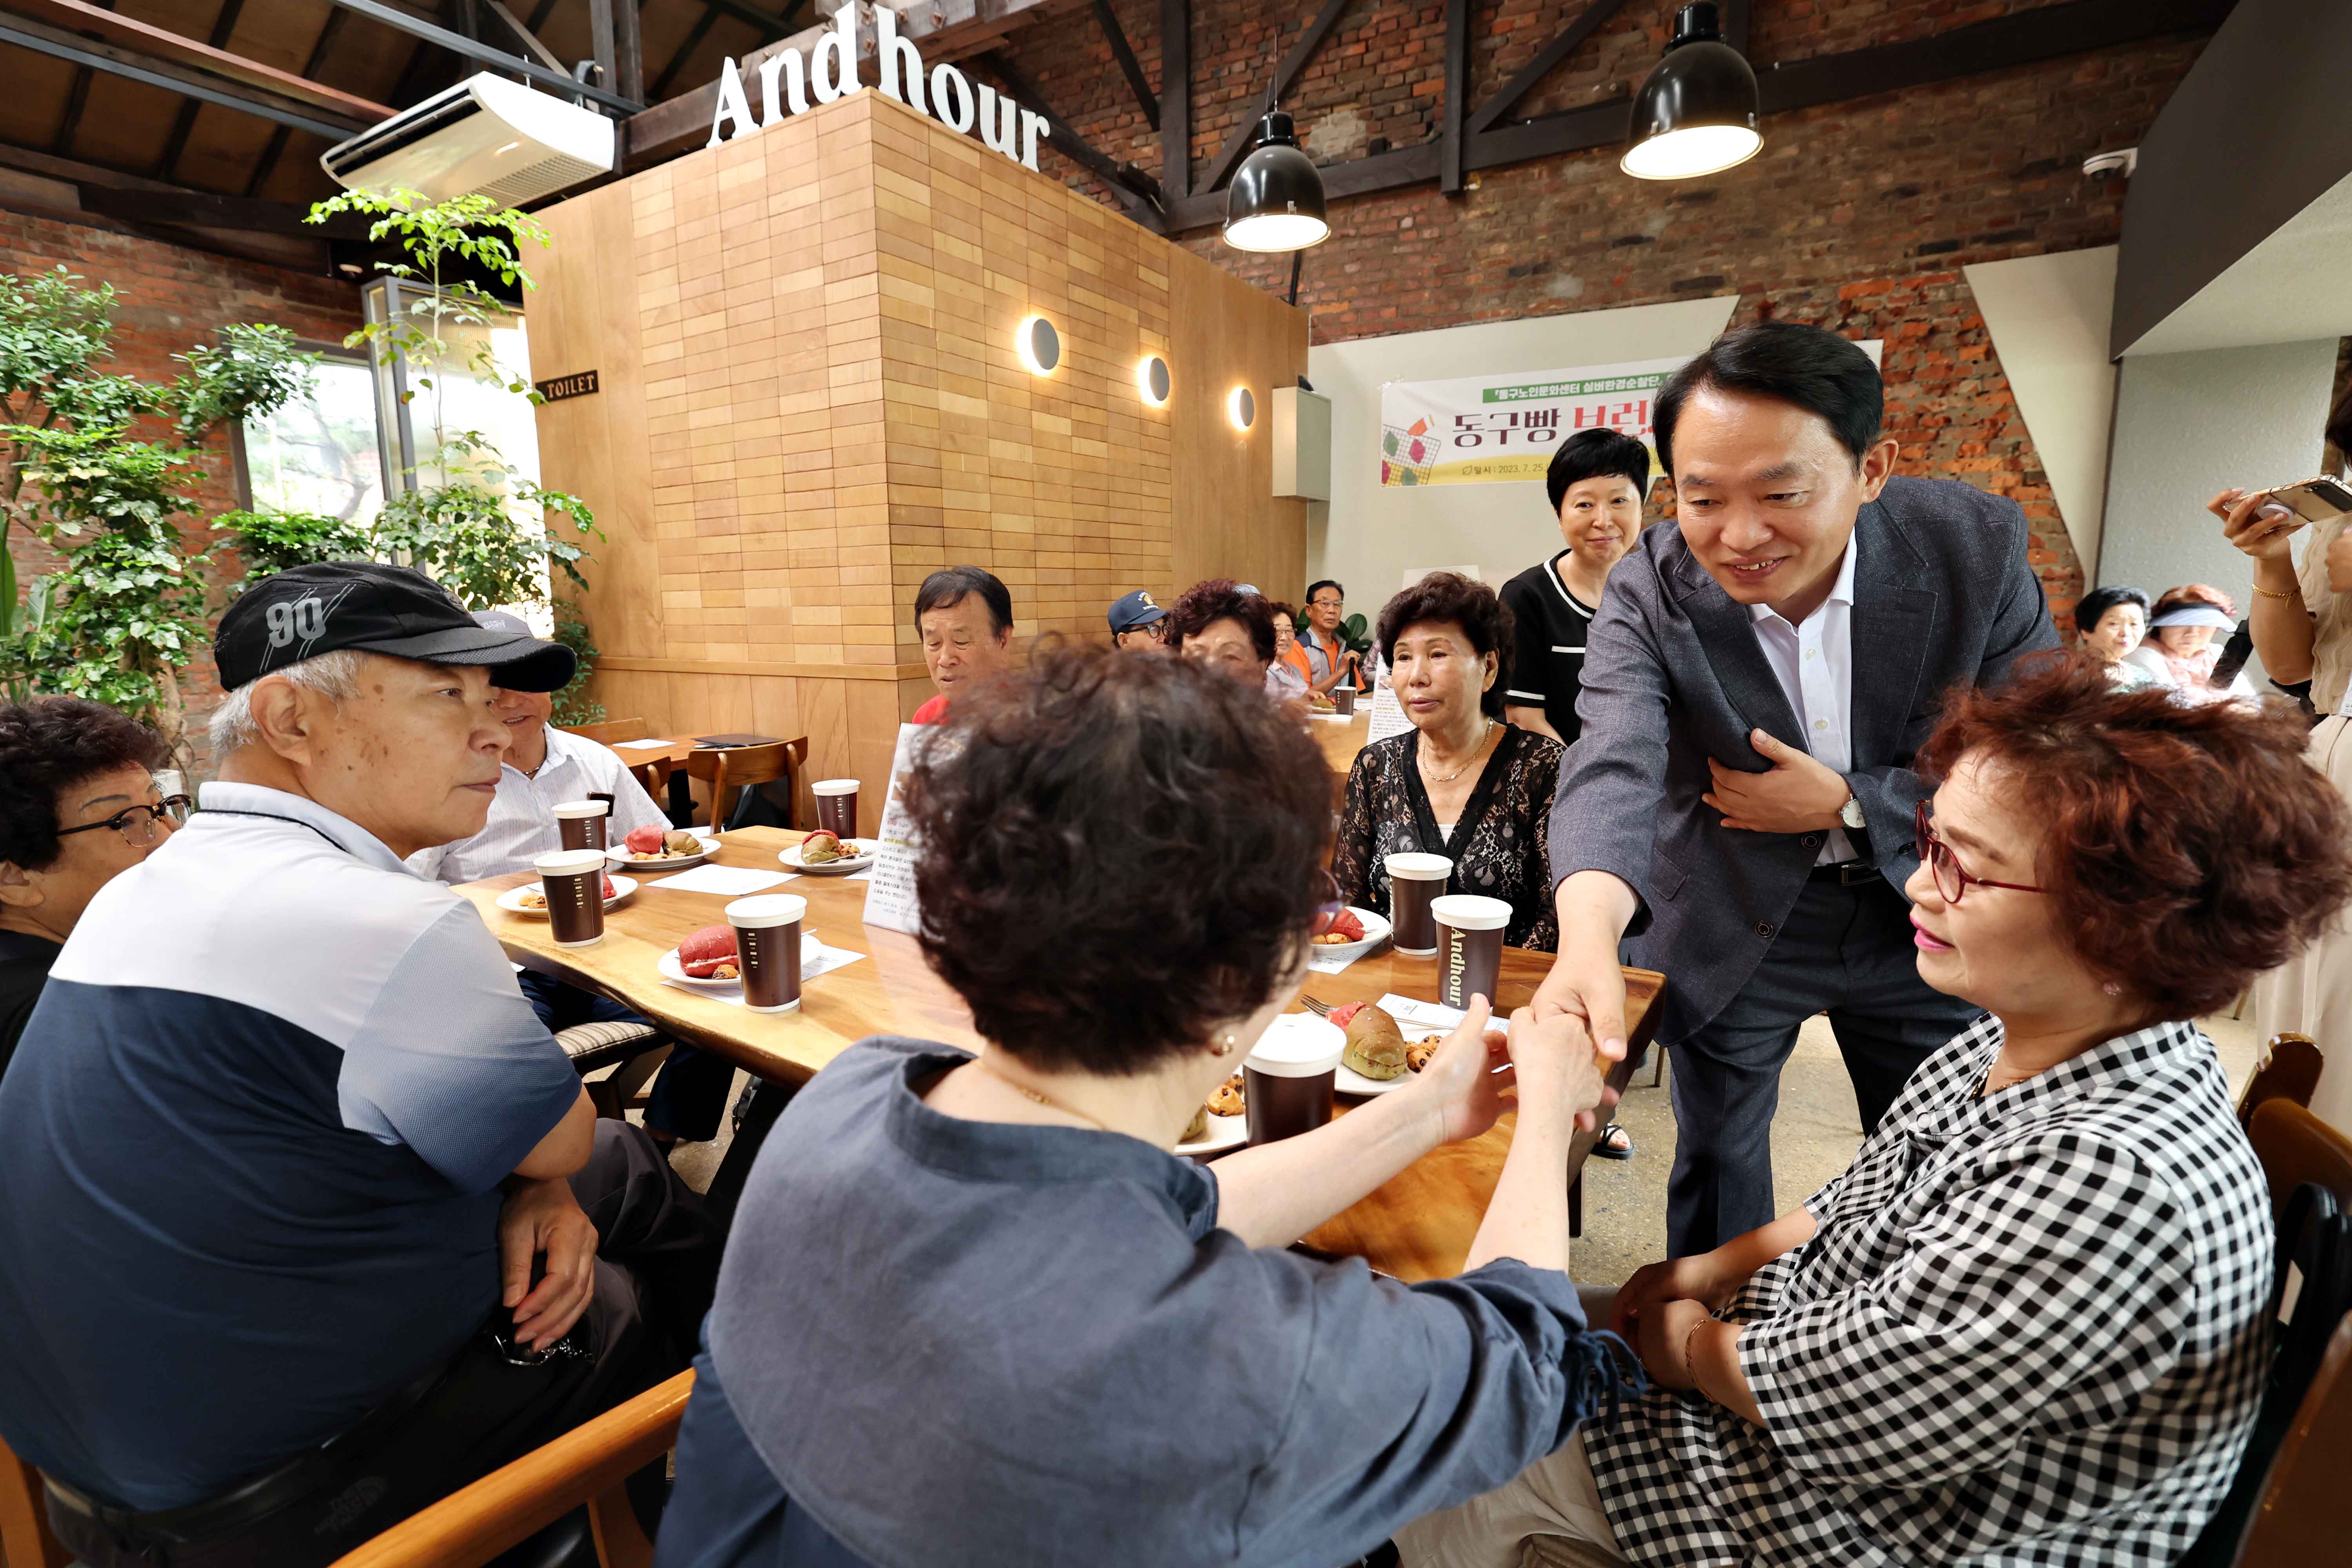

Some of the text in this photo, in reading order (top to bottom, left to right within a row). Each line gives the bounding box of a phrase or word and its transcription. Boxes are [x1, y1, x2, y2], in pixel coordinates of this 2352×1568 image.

[706, 0, 1050, 173] And hour
[547, 374, 594, 399] TOILET
[1452, 399, 1653, 447] 동구빵 브런
[1499, 465, 1520, 473] 2023.
[266, 597, 327, 648] 90
[1450, 926, 1466, 1007] Andhour
